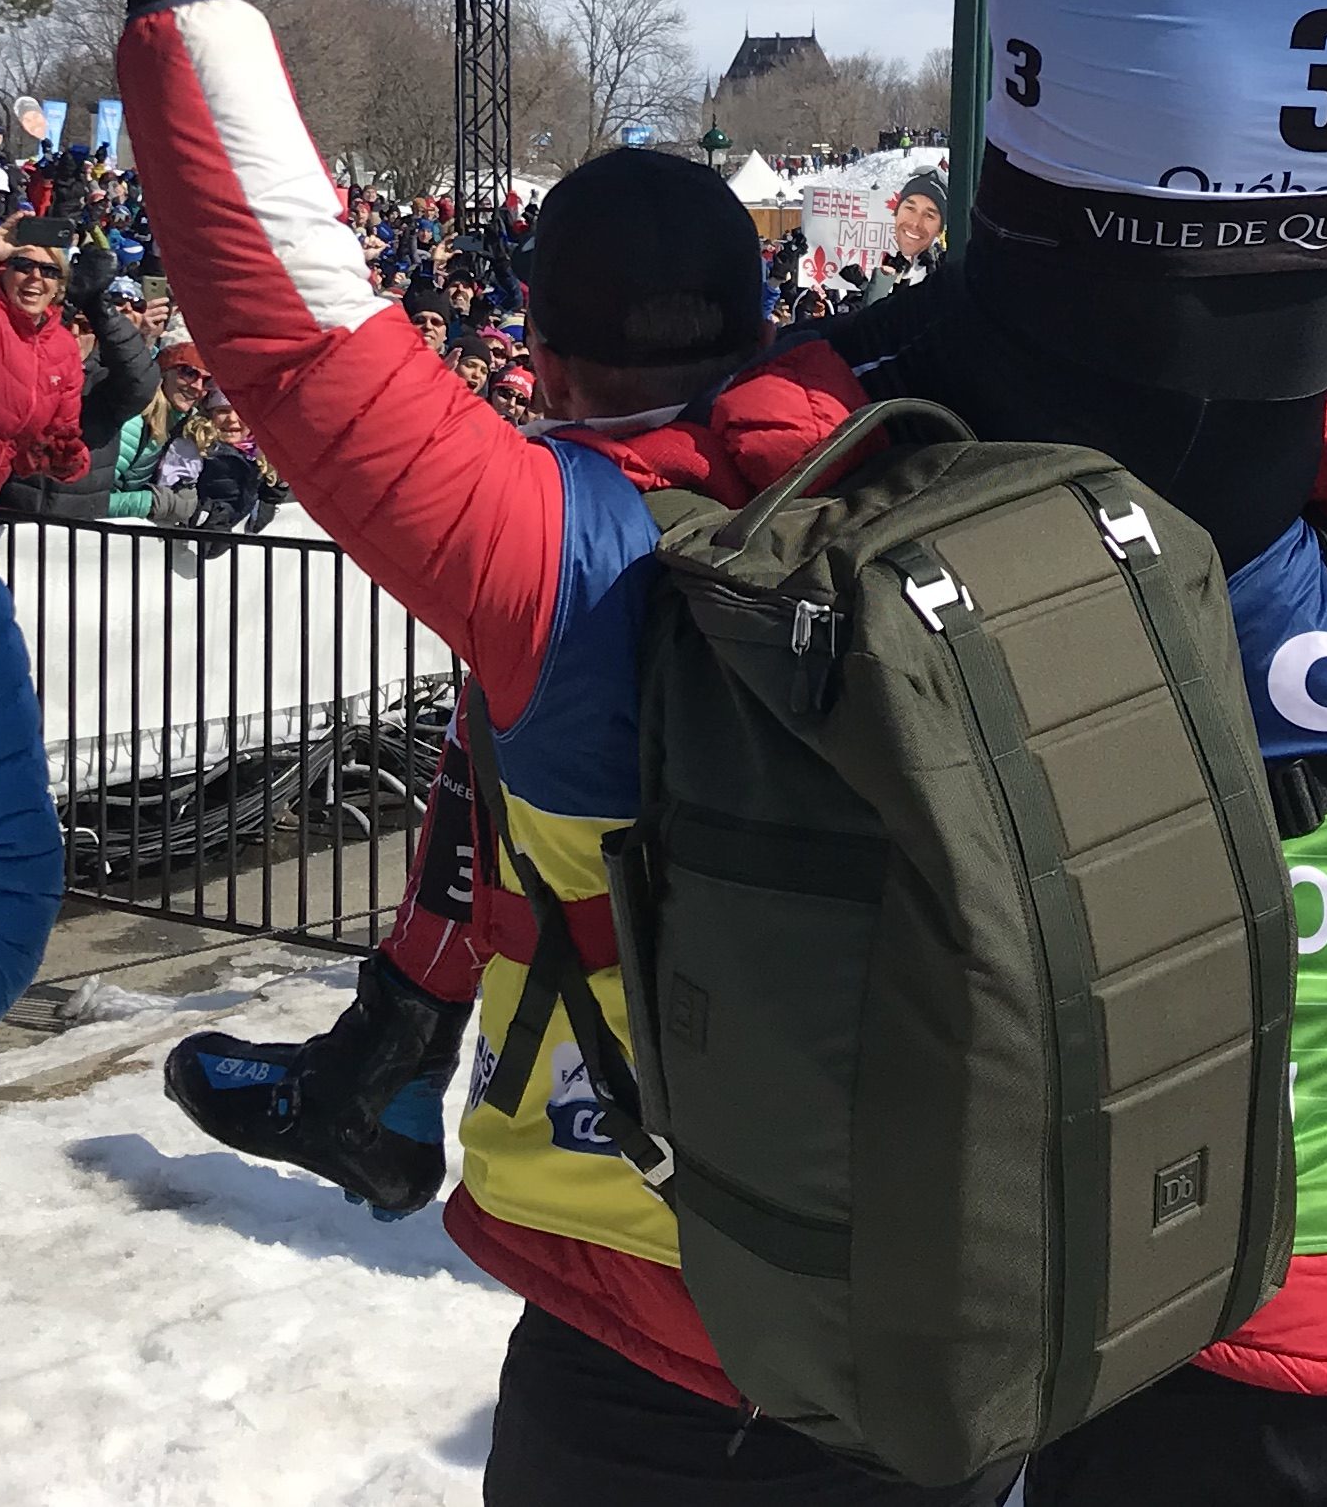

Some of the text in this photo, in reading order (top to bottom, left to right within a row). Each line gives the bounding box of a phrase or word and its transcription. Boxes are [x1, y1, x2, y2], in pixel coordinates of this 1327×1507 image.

[1005, 38, 1043, 108] 3
[811, 187, 870, 220] ONE
[838, 219, 900, 251] MOR
[1084, 206, 1204, 249] VILLE
[1216, 219, 1268, 247] DE
[446, 845, 474, 903] 3
